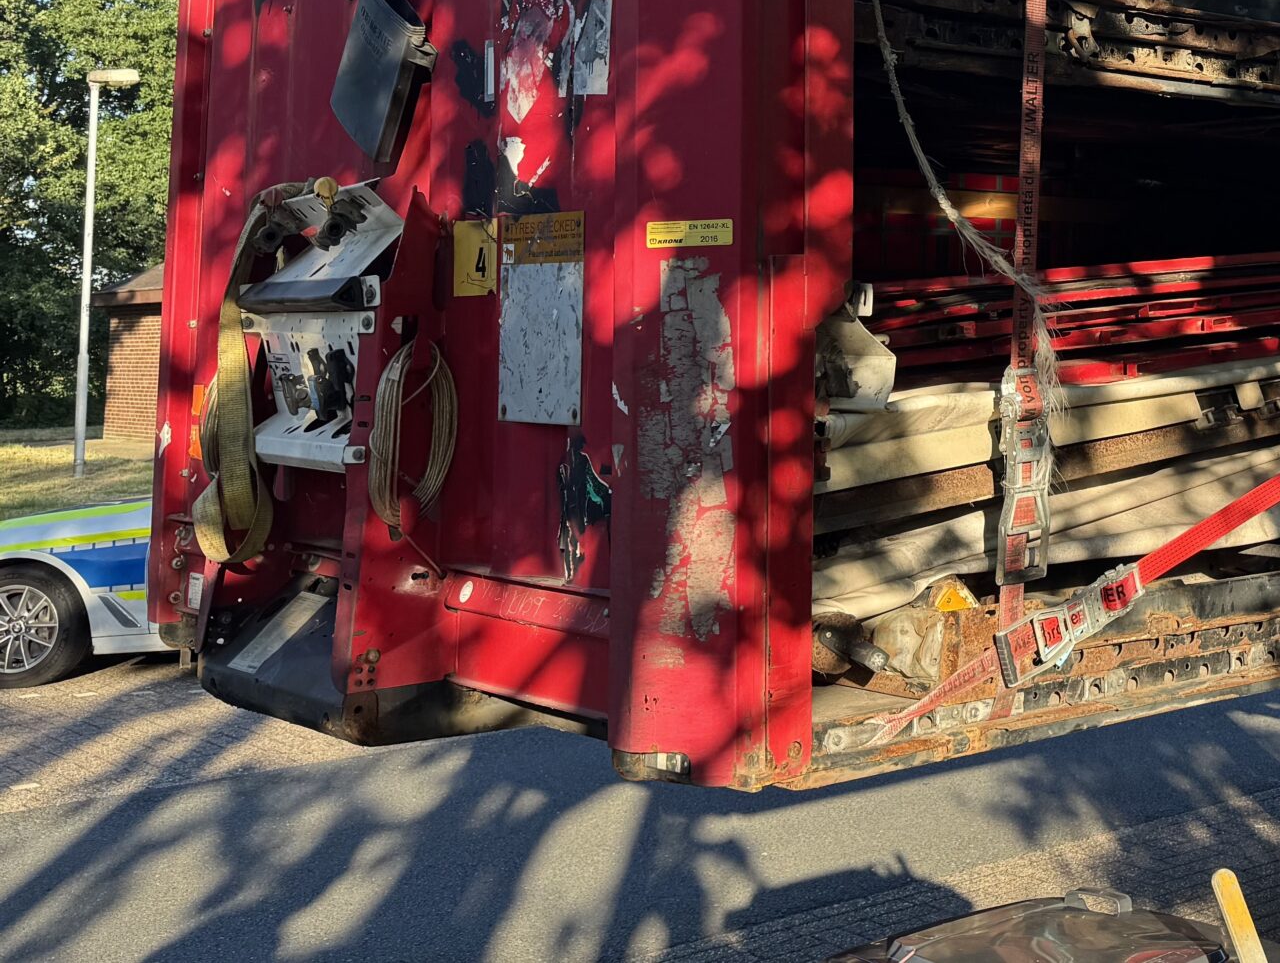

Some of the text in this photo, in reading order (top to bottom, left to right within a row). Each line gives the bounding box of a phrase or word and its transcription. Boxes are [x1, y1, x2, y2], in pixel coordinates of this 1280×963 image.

[1025, 52, 1039, 123] WALTER
[509, 222, 535, 235] TYRES
[475, 247, 486, 278] 4
